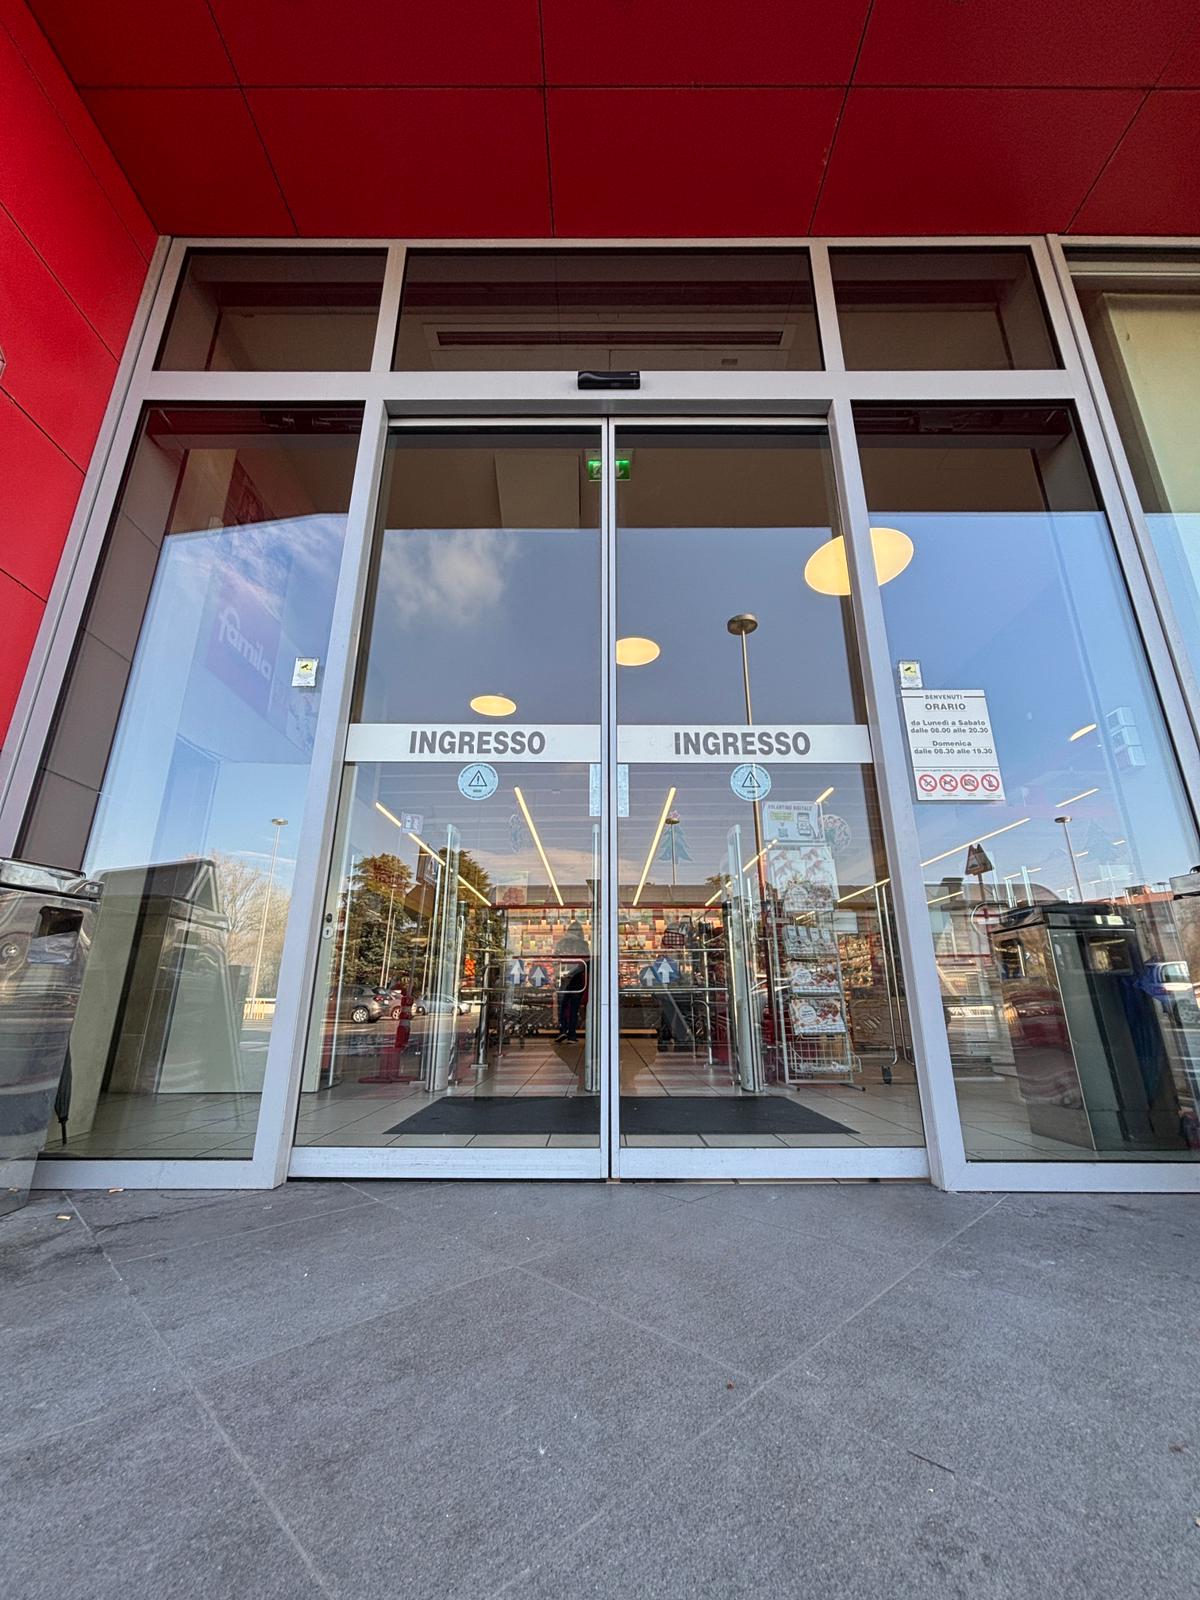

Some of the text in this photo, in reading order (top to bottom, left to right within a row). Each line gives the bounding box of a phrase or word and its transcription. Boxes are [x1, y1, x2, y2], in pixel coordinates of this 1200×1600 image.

[925, 703, 966, 711] ORARIO
[409, 730, 546, 755] INGRESSO
[674, 731, 811, 756] INGRESSO
